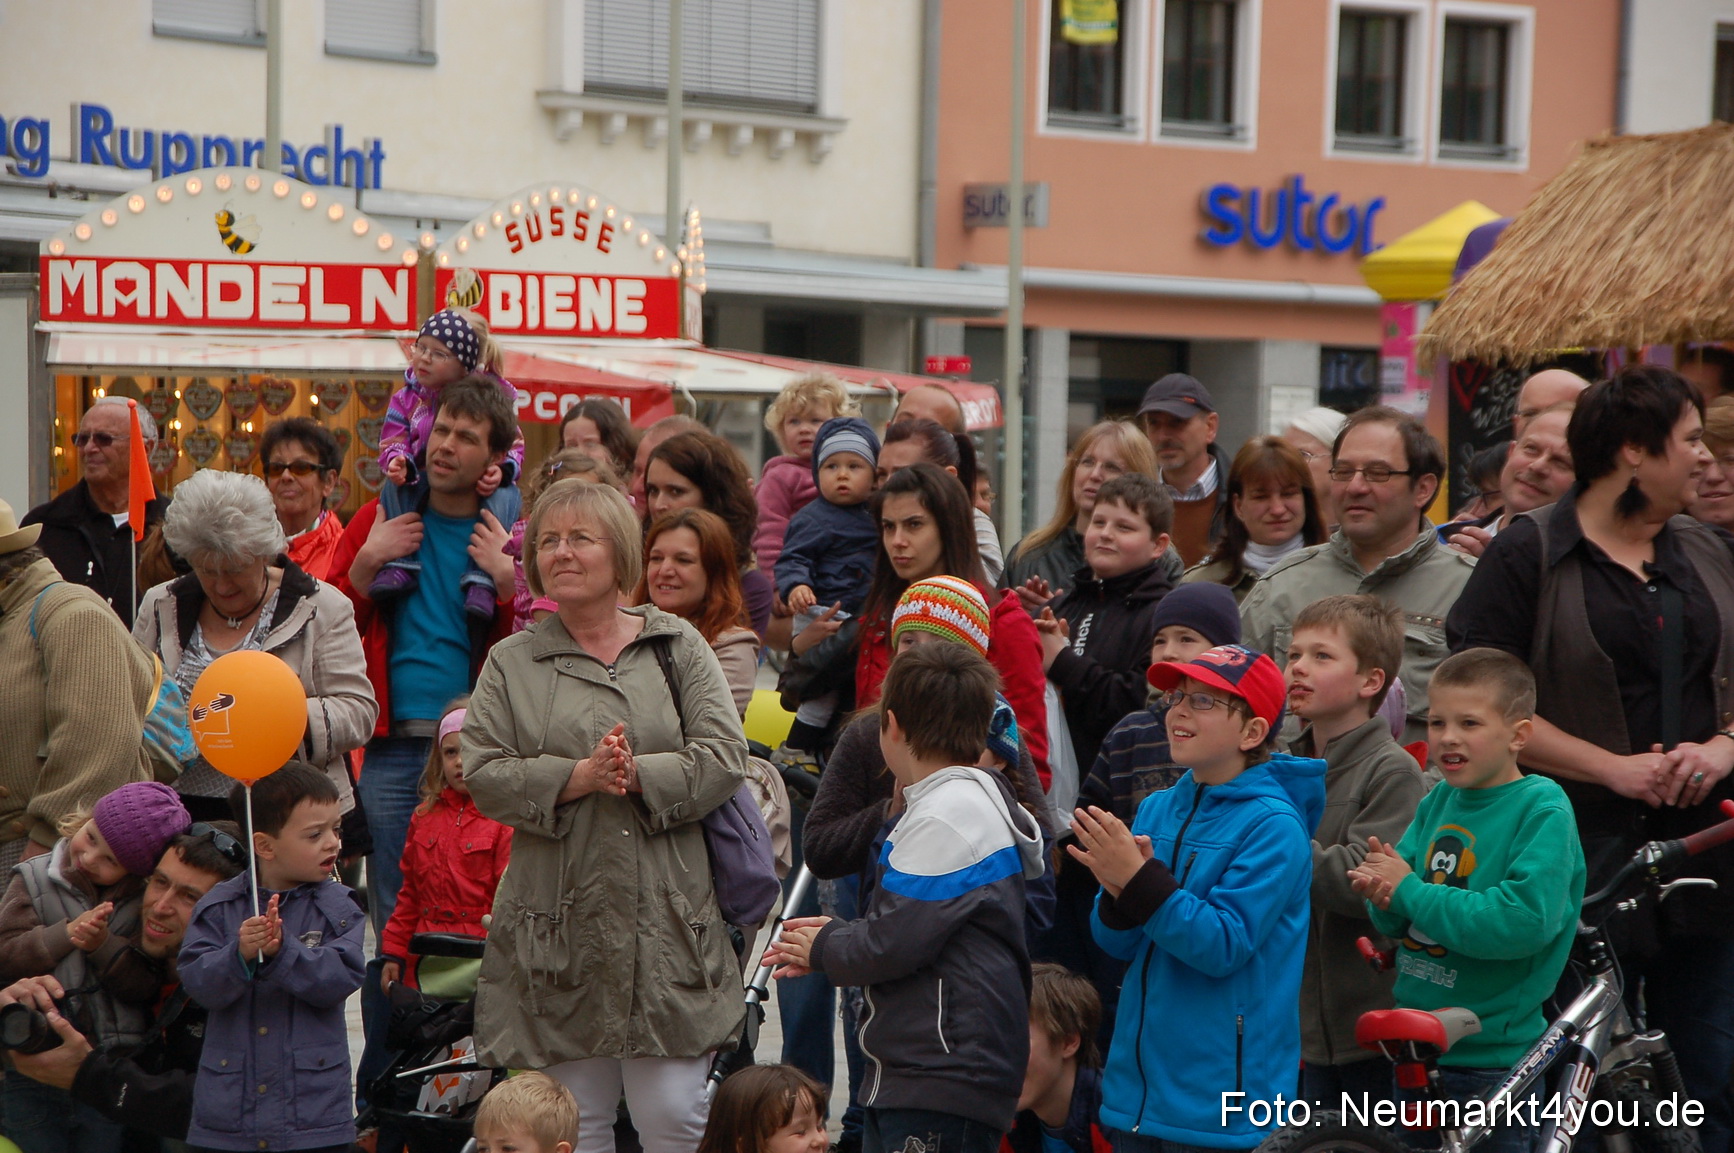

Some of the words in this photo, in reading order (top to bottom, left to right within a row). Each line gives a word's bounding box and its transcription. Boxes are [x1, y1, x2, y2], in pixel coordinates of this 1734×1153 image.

[0, 113, 50, 177] g
[49, 260, 409, 325] MANDELN
[489, 273, 648, 334] BIENE
[1074, 613, 1094, 657] ench.
[1519, 1027, 1565, 1077] TEAM
